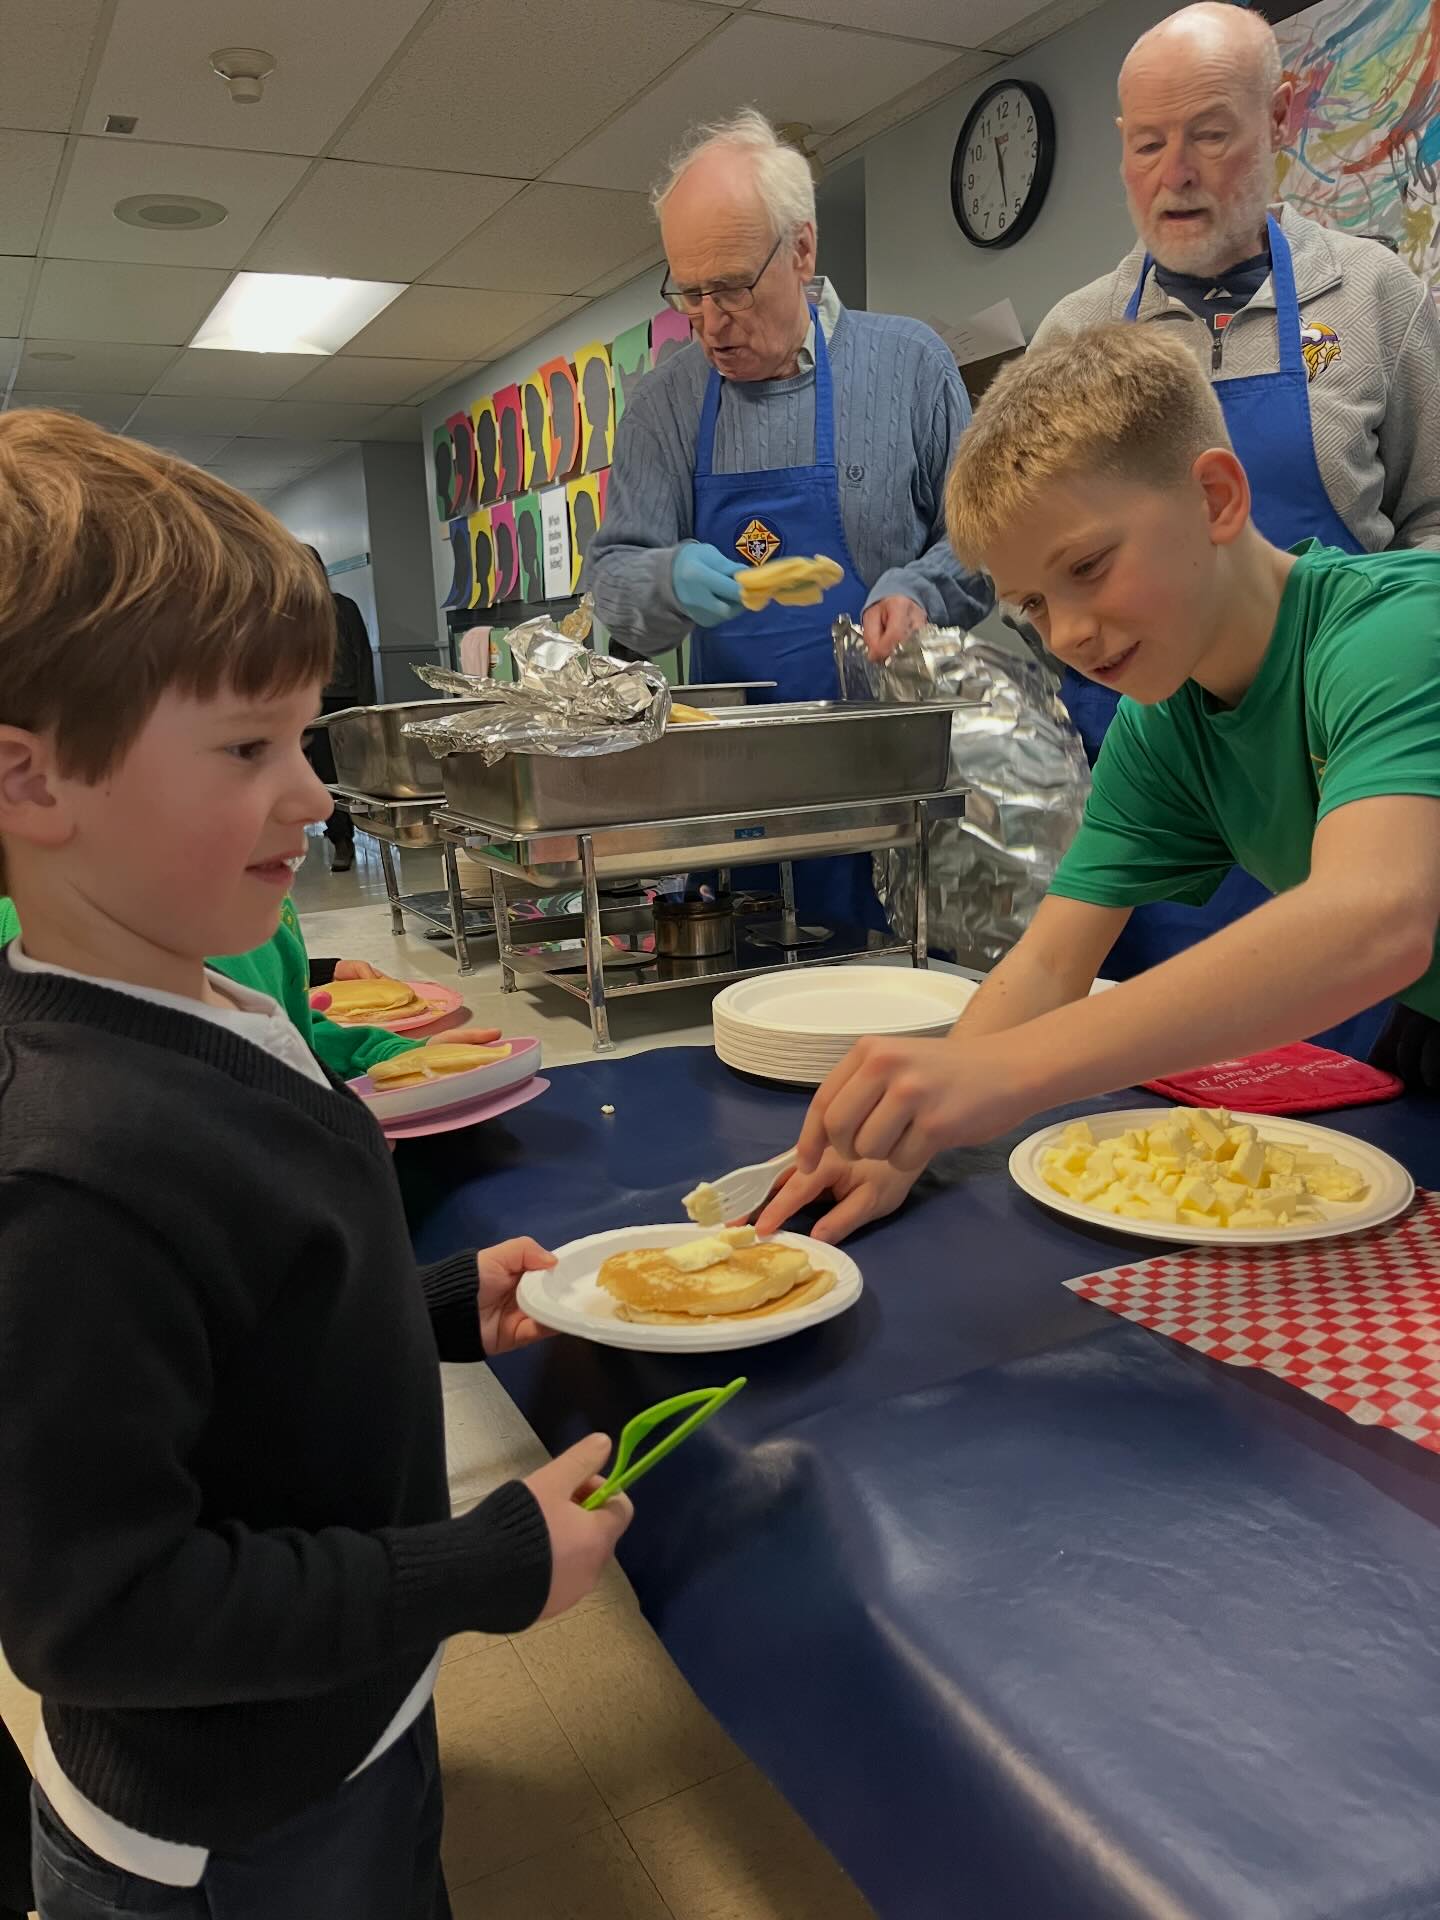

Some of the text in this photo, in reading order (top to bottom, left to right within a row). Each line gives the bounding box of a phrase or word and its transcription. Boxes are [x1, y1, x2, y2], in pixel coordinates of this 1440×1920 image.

[997, 101, 1009, 121] 12
[1016, 101, 1021, 118] 1
[981, 119, 991, 139] 11
[1026, 115, 1034, 133] 2
[969, 144, 982, 164] 10
[1031, 140, 1038, 159] 3
[968, 173, 975, 190] 9
[972, 198, 979, 215] 8
[1014, 197, 1023, 216] 5
[983, 212, 991, 229] 7
[998, 212, 1006, 228] 6
[1198, 1078, 1210, 1087] IT
